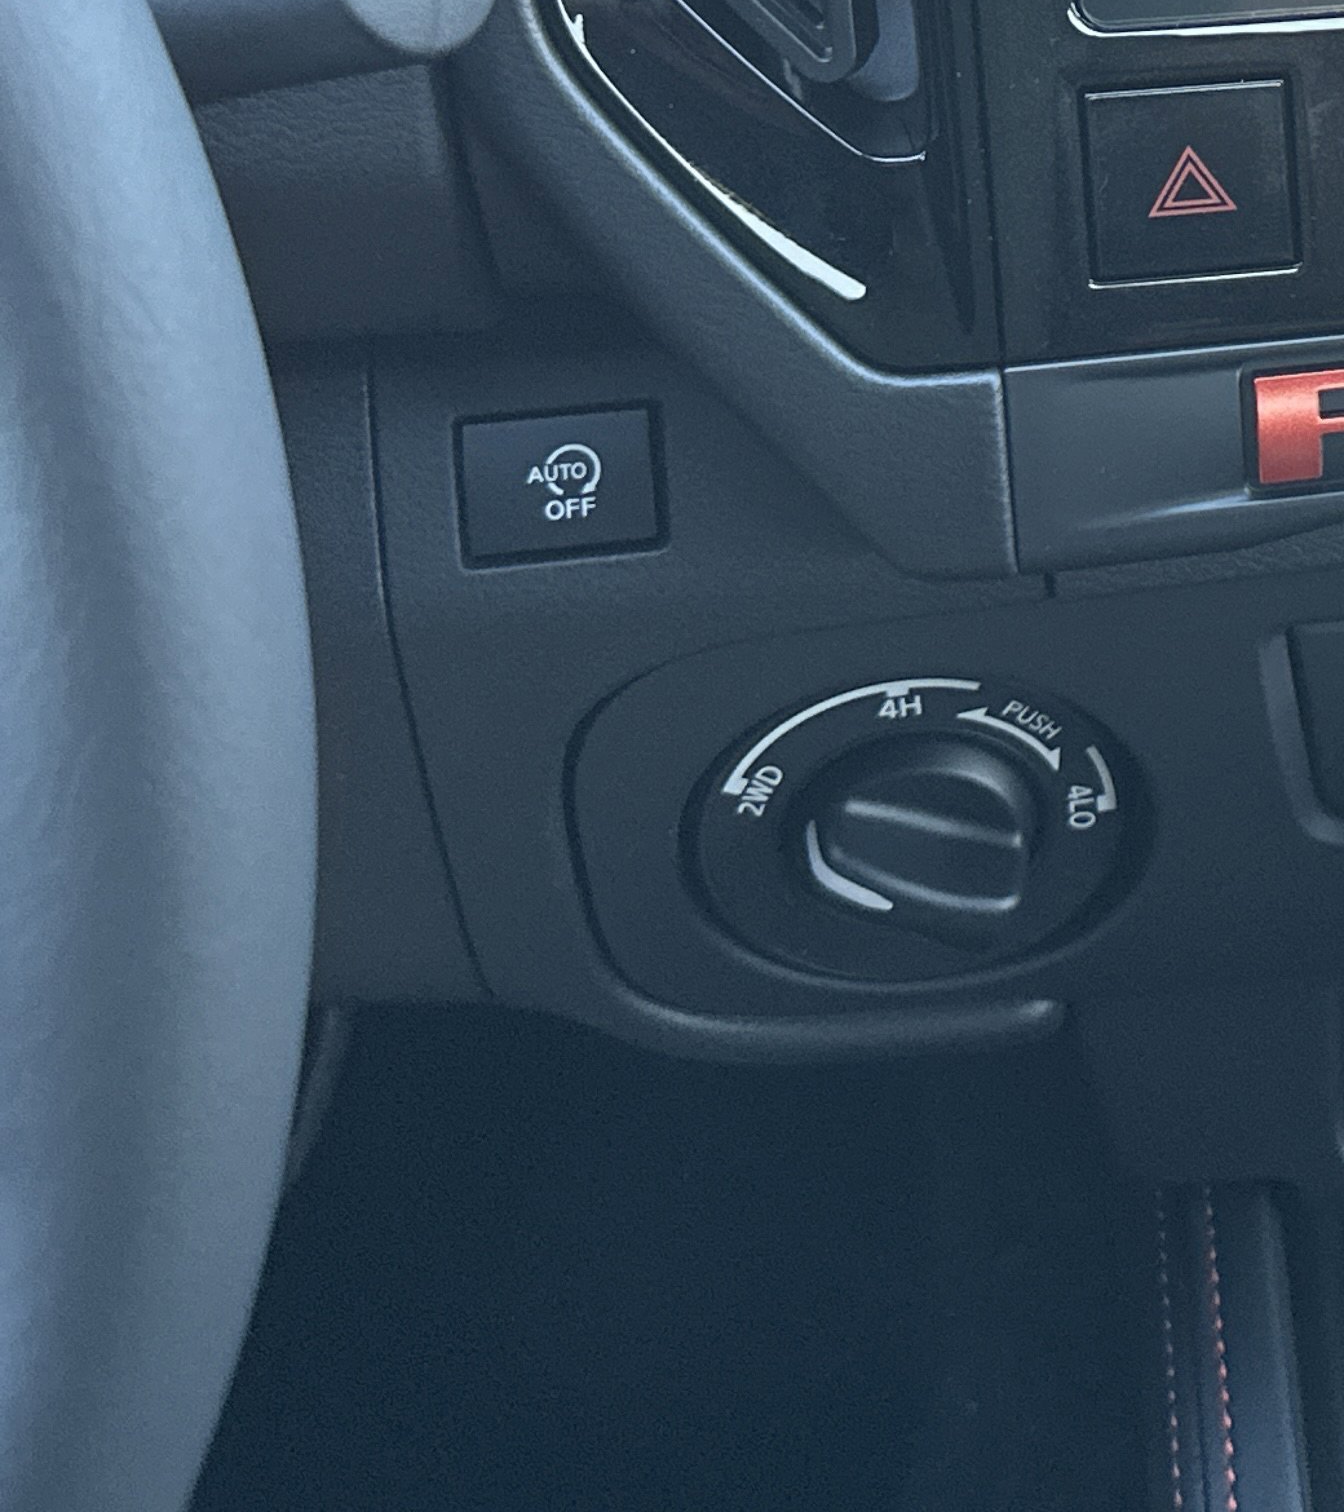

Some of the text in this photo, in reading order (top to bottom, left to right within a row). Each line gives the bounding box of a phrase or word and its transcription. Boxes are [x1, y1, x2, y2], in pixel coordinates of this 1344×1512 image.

[526, 461, 588, 485] AUTO
[545, 496, 597, 521] OFF
[878, 695, 923, 719] 4H
[1002, 699, 1063, 740] PUSH
[737, 764, 784, 818] 2WD
[1067, 784, 1096, 830] 4LO
